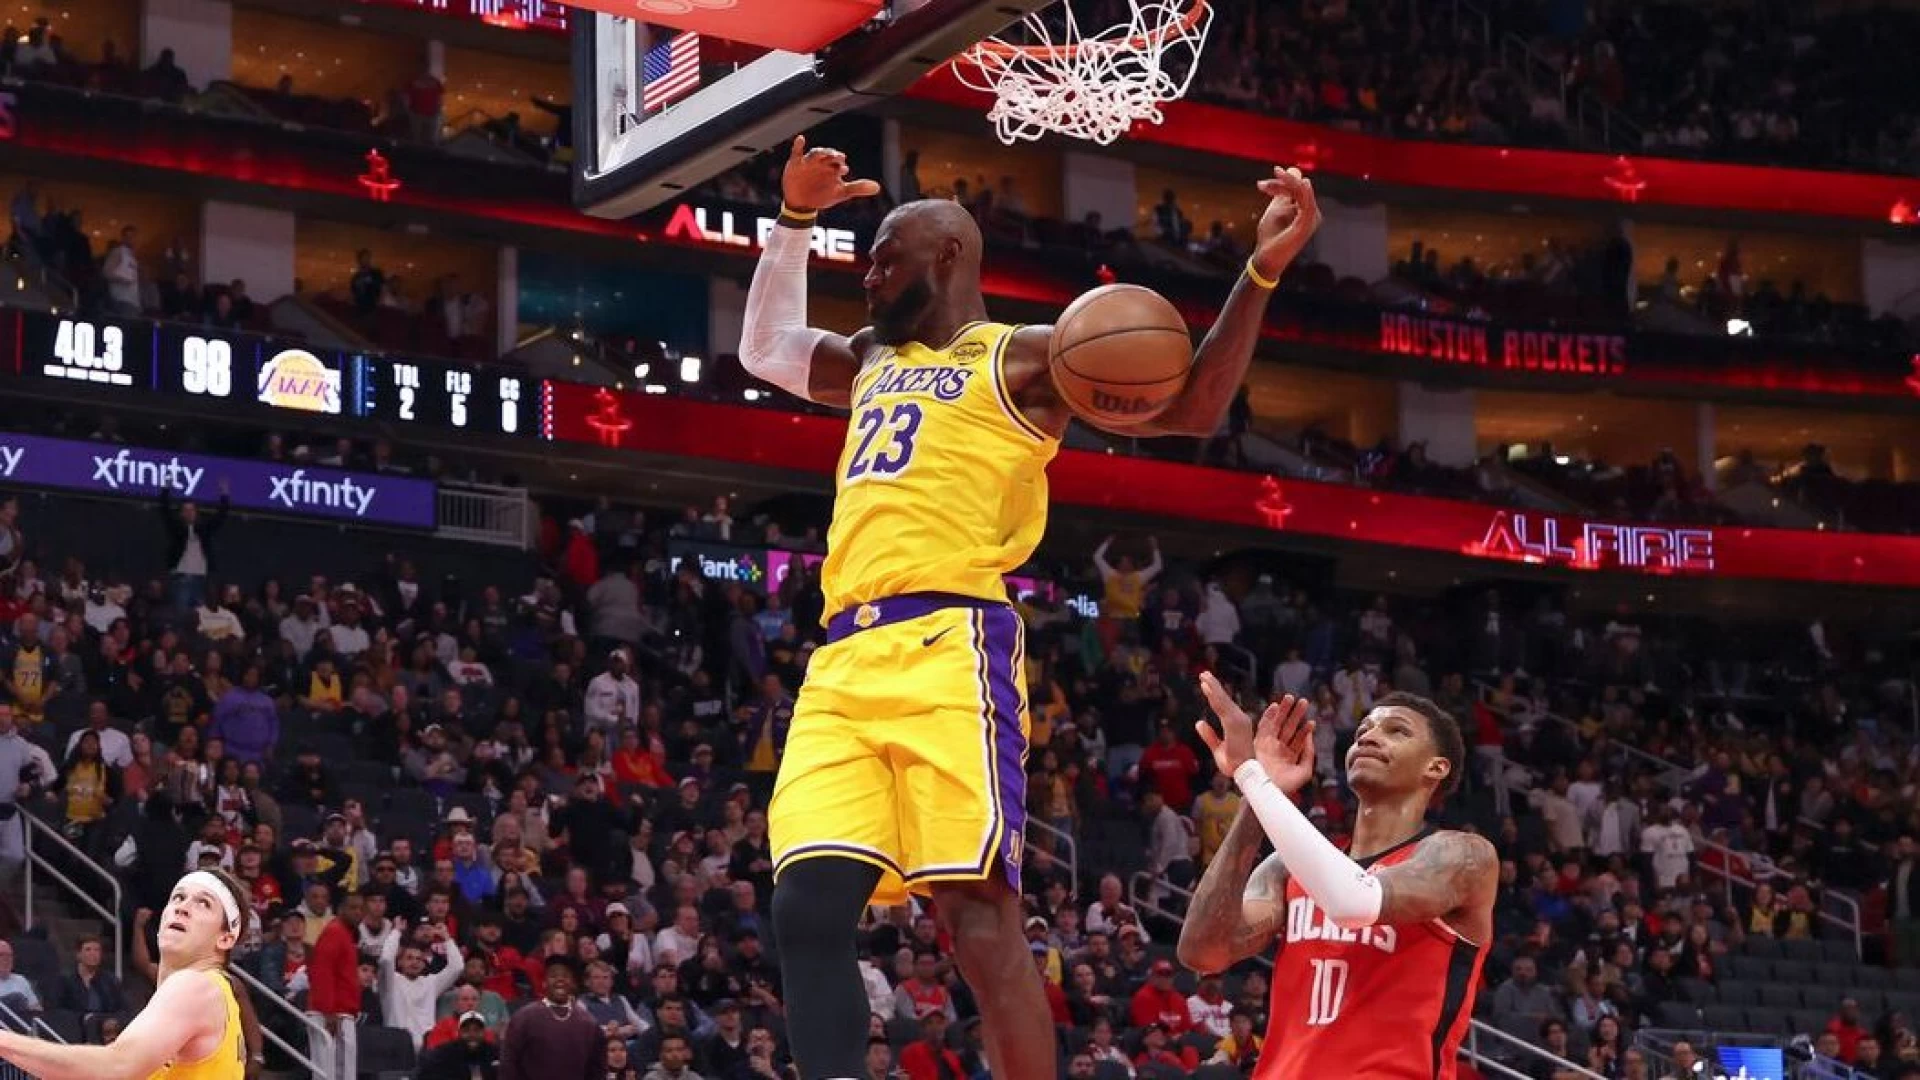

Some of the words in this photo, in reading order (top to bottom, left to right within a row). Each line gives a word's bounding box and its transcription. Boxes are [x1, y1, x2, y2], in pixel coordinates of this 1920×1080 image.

[665, 203, 750, 246] ALL
[757, 217, 855, 262] FRE
[54, 320, 123, 372] 40.3
[182, 336, 232, 396] 98
[1380, 311, 1488, 365] HOUSTON
[1503, 329, 1626, 375] ROCKETS
[399, 387, 415, 420] 2
[451, 394, 467, 426] 5
[501, 400, 518, 433] 0
[856, 364, 973, 408] LAKERS
[846, 401, 923, 480] 23
[93, 449, 204, 496] xfinity
[269, 469, 375, 516] xfinity
[1482, 511, 1576, 560] ALL
[1583, 522, 1714, 570] FIRE
[1306, 958, 1349, 1025] 10
